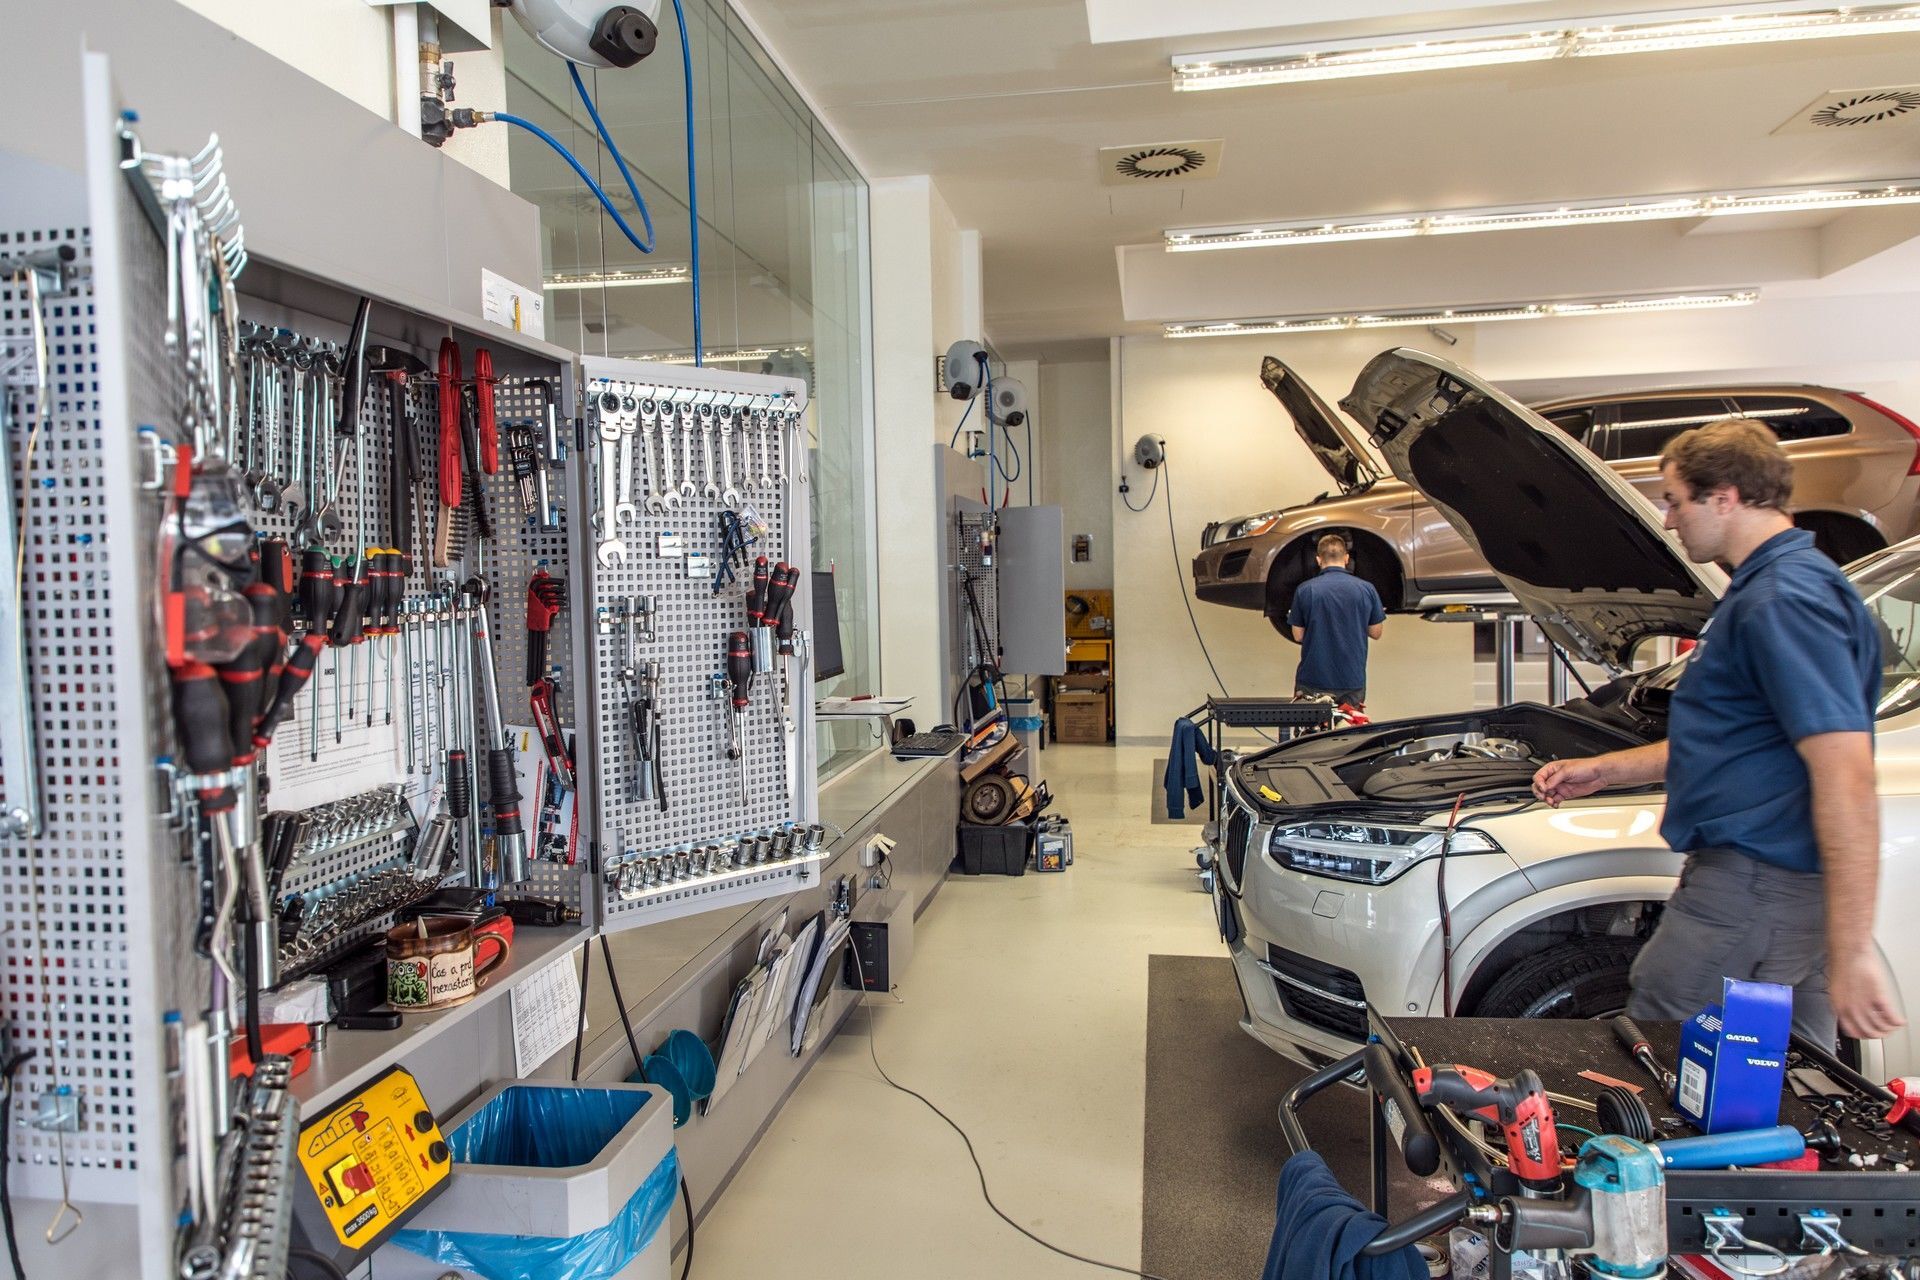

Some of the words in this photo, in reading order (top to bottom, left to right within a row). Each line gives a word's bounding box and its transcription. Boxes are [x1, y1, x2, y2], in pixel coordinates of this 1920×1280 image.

[431, 962, 447, 978] Čas
[450, 966, 458, 975] a
[1725, 1033, 1760, 1043] VOLVO
[1693, 1041, 1714, 1057] VOLVO
[1746, 1058, 1781, 1068] VOLVO
